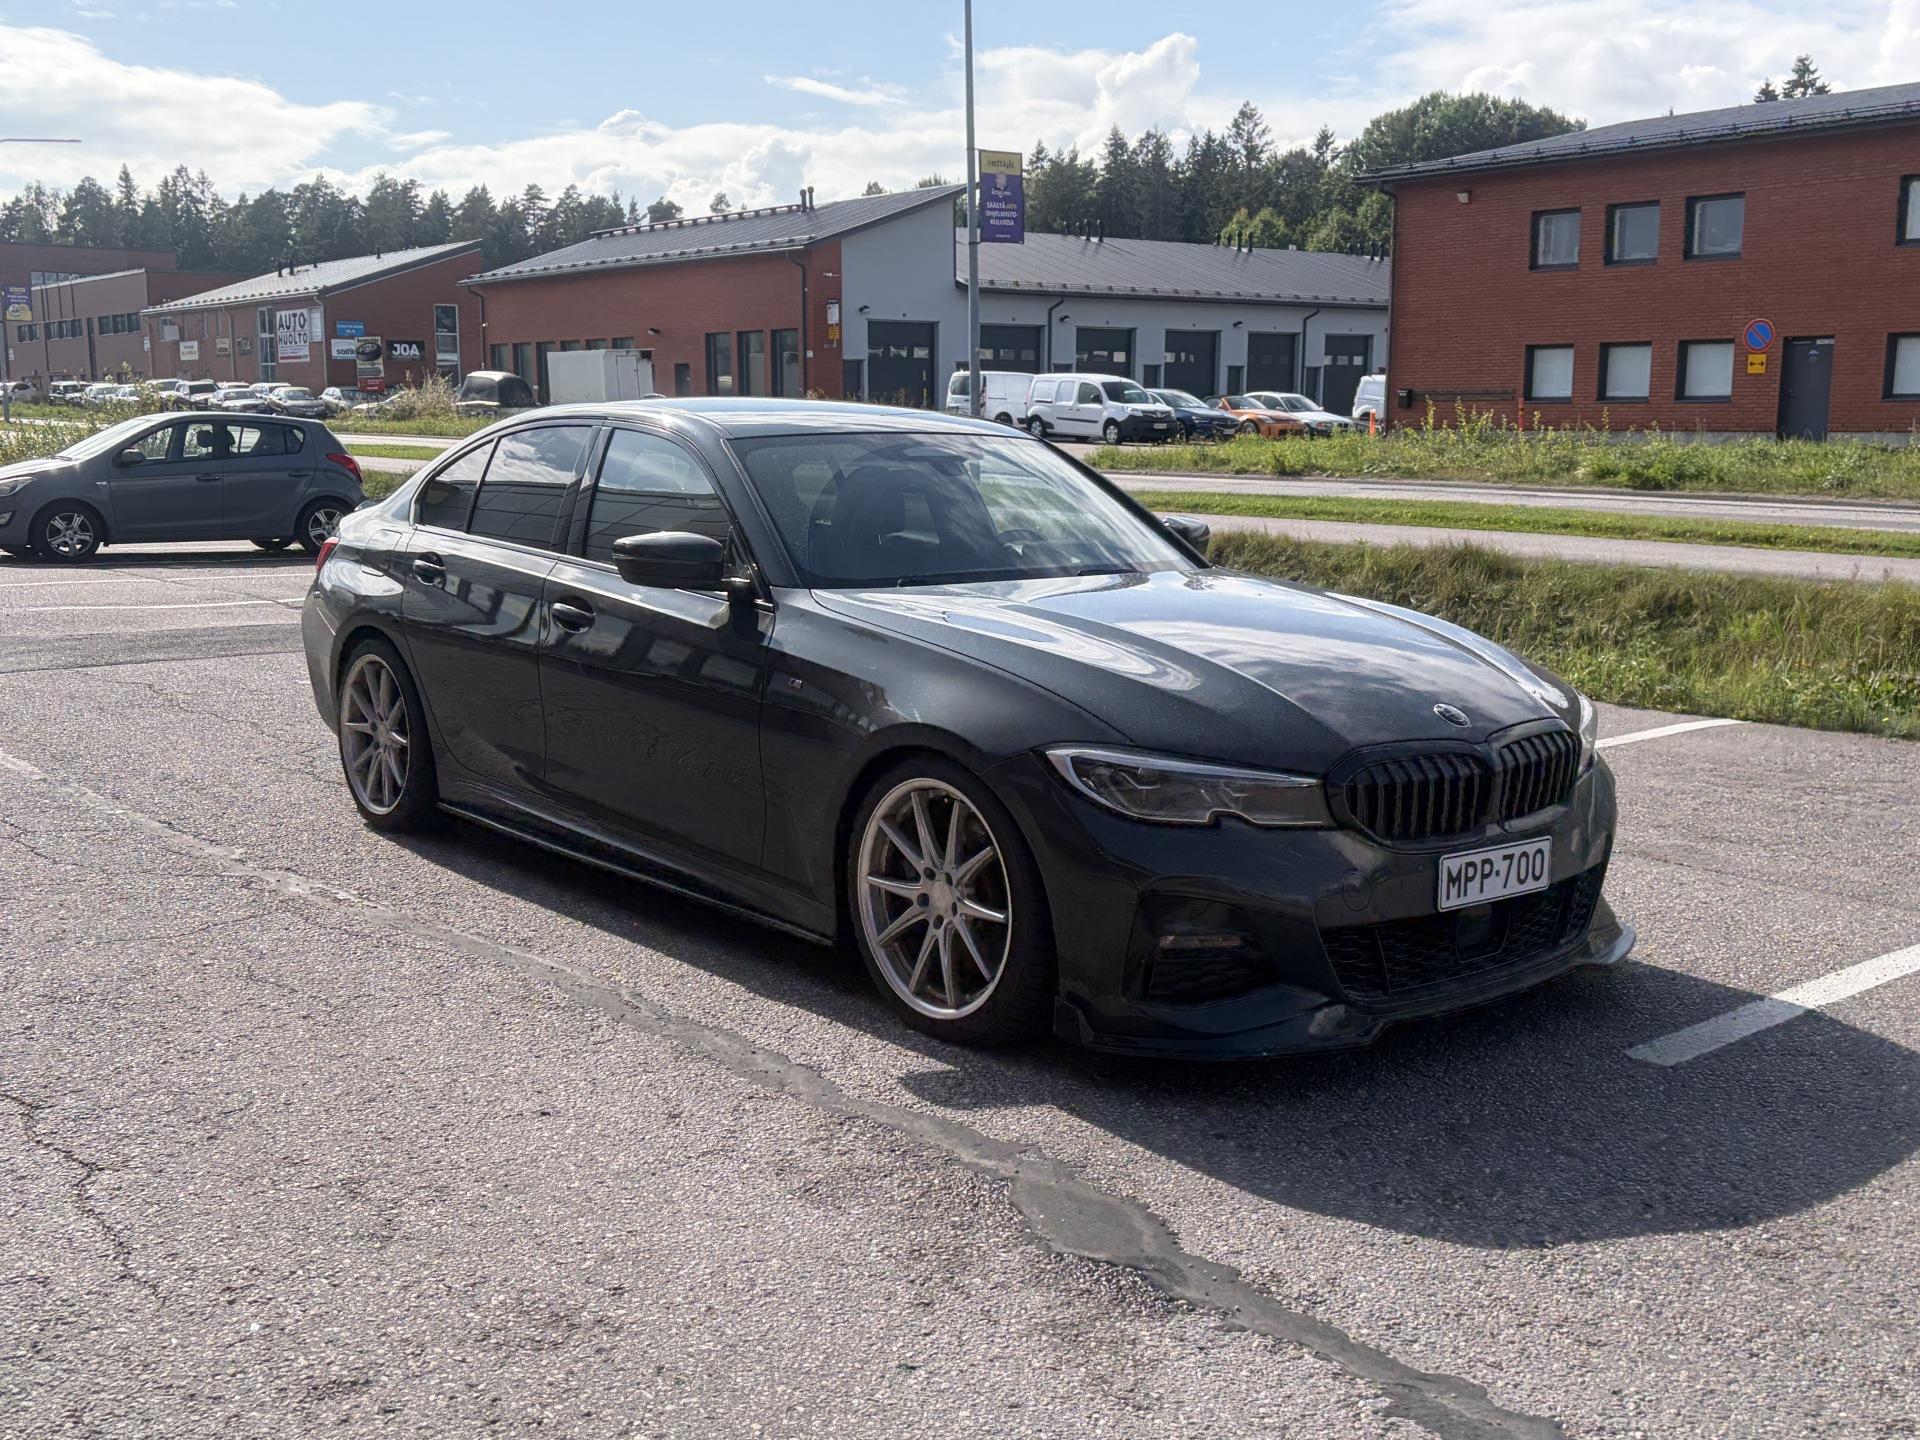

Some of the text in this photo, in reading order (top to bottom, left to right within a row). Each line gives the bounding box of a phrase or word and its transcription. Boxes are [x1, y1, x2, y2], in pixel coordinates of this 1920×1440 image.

[278, 312, 307, 331] AUTO
[278, 333, 308, 346] HUOLTO
[392, 343, 420, 356] JOA
[1446, 848, 1545, 901] MPP-700
